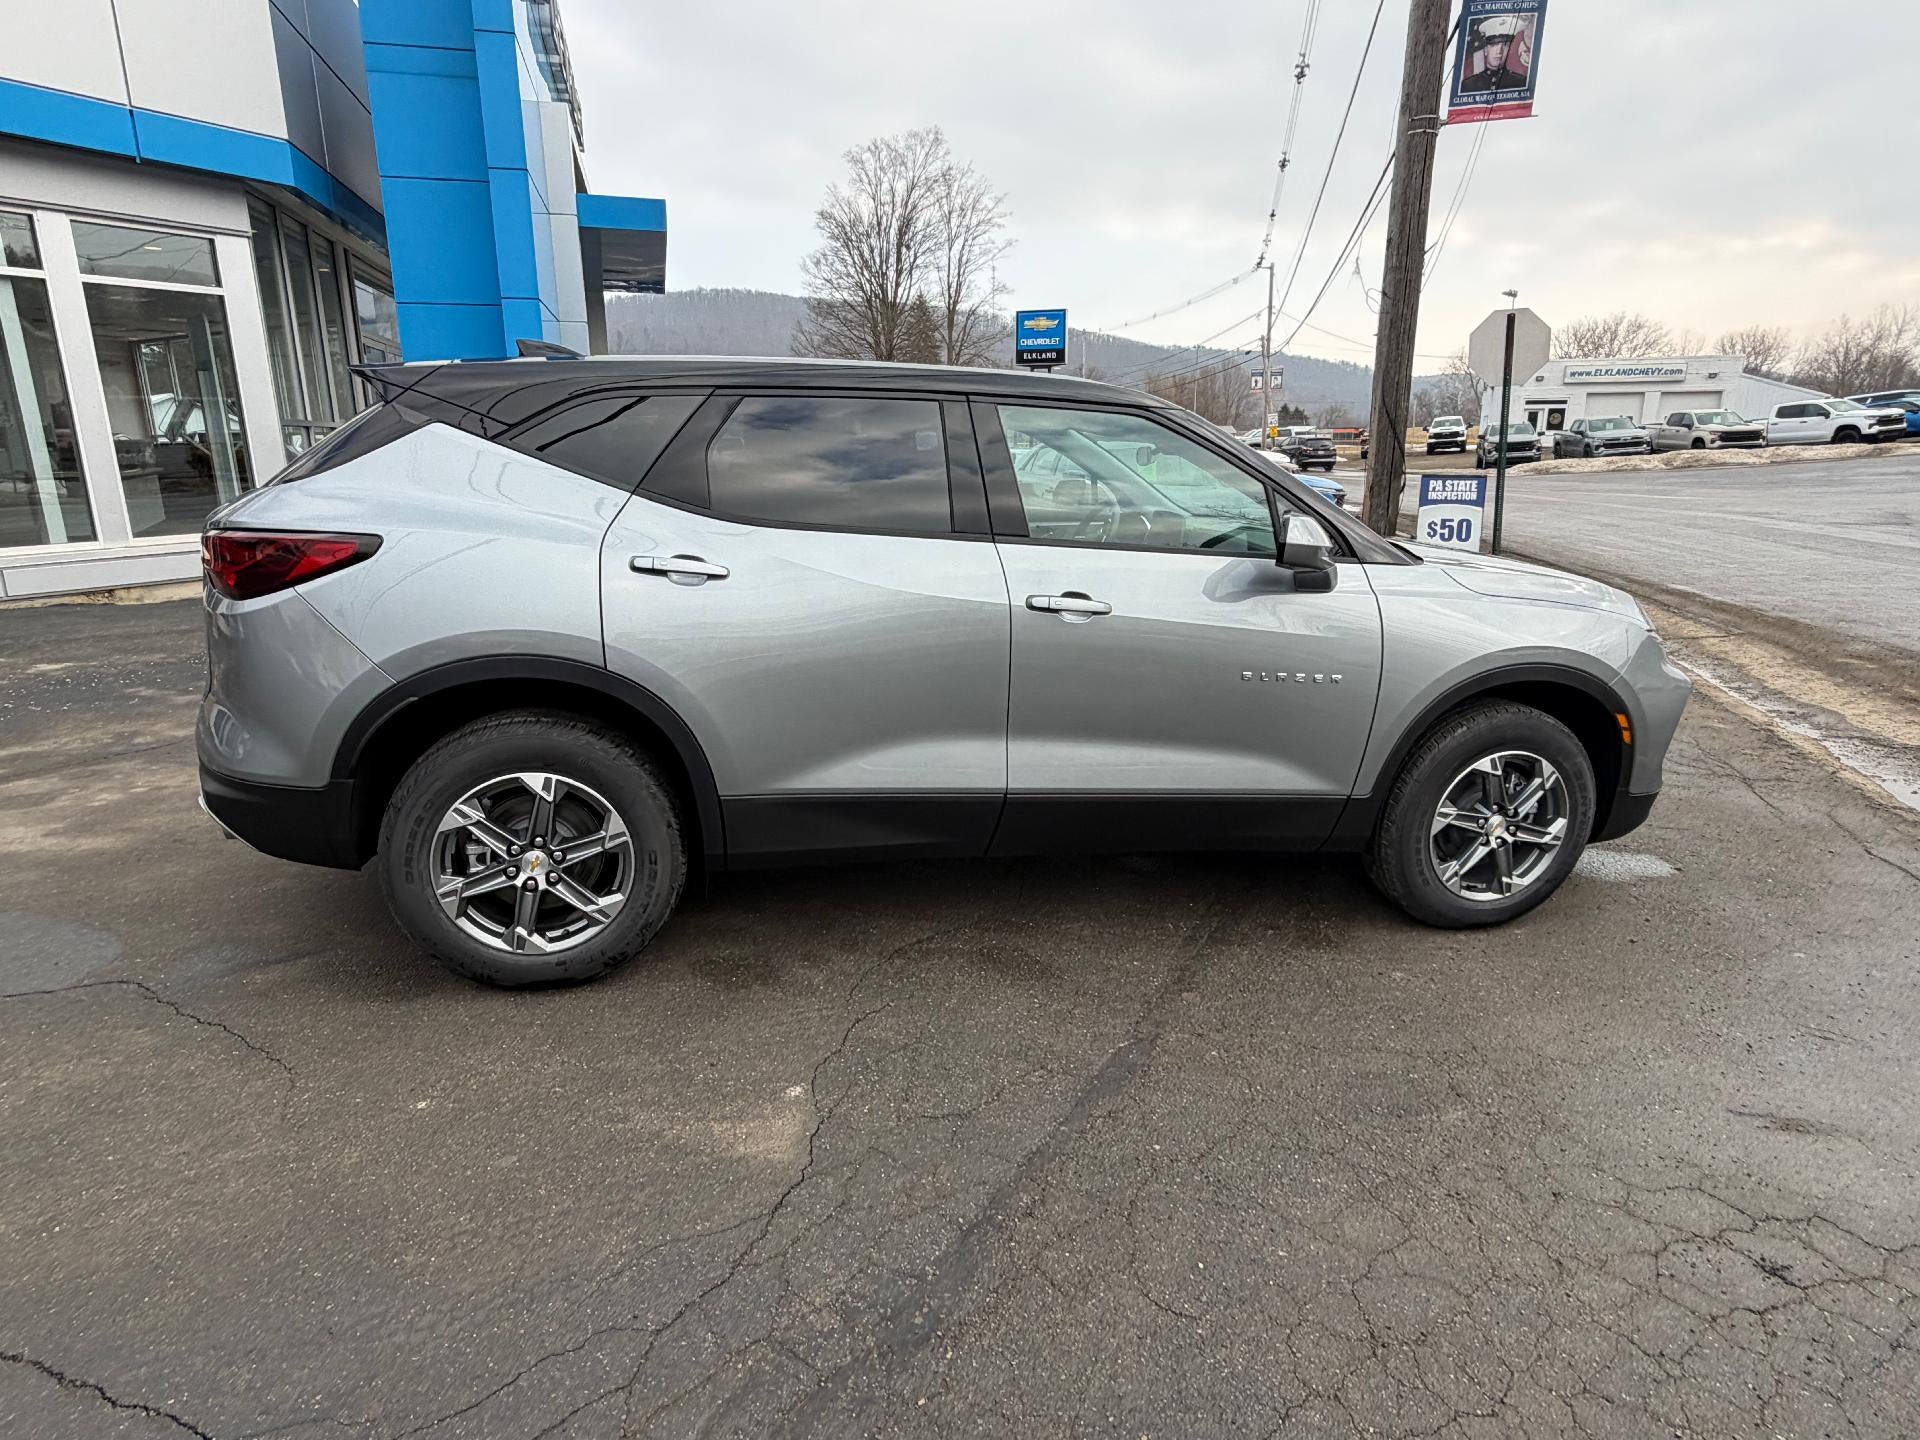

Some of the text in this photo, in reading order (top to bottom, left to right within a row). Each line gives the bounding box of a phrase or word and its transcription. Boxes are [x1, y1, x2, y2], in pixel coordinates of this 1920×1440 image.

[1020, 337, 1060, 346] CHEVROLET
[1569, 367, 1683, 378] www.ELKLANDCHEVY.com
[1428, 480, 1478, 492] PA STATE
[1428, 491, 1477, 500] INSPECTION
[1426, 518, 1473, 543] $50
[1241, 671, 1343, 684] BLAZER
